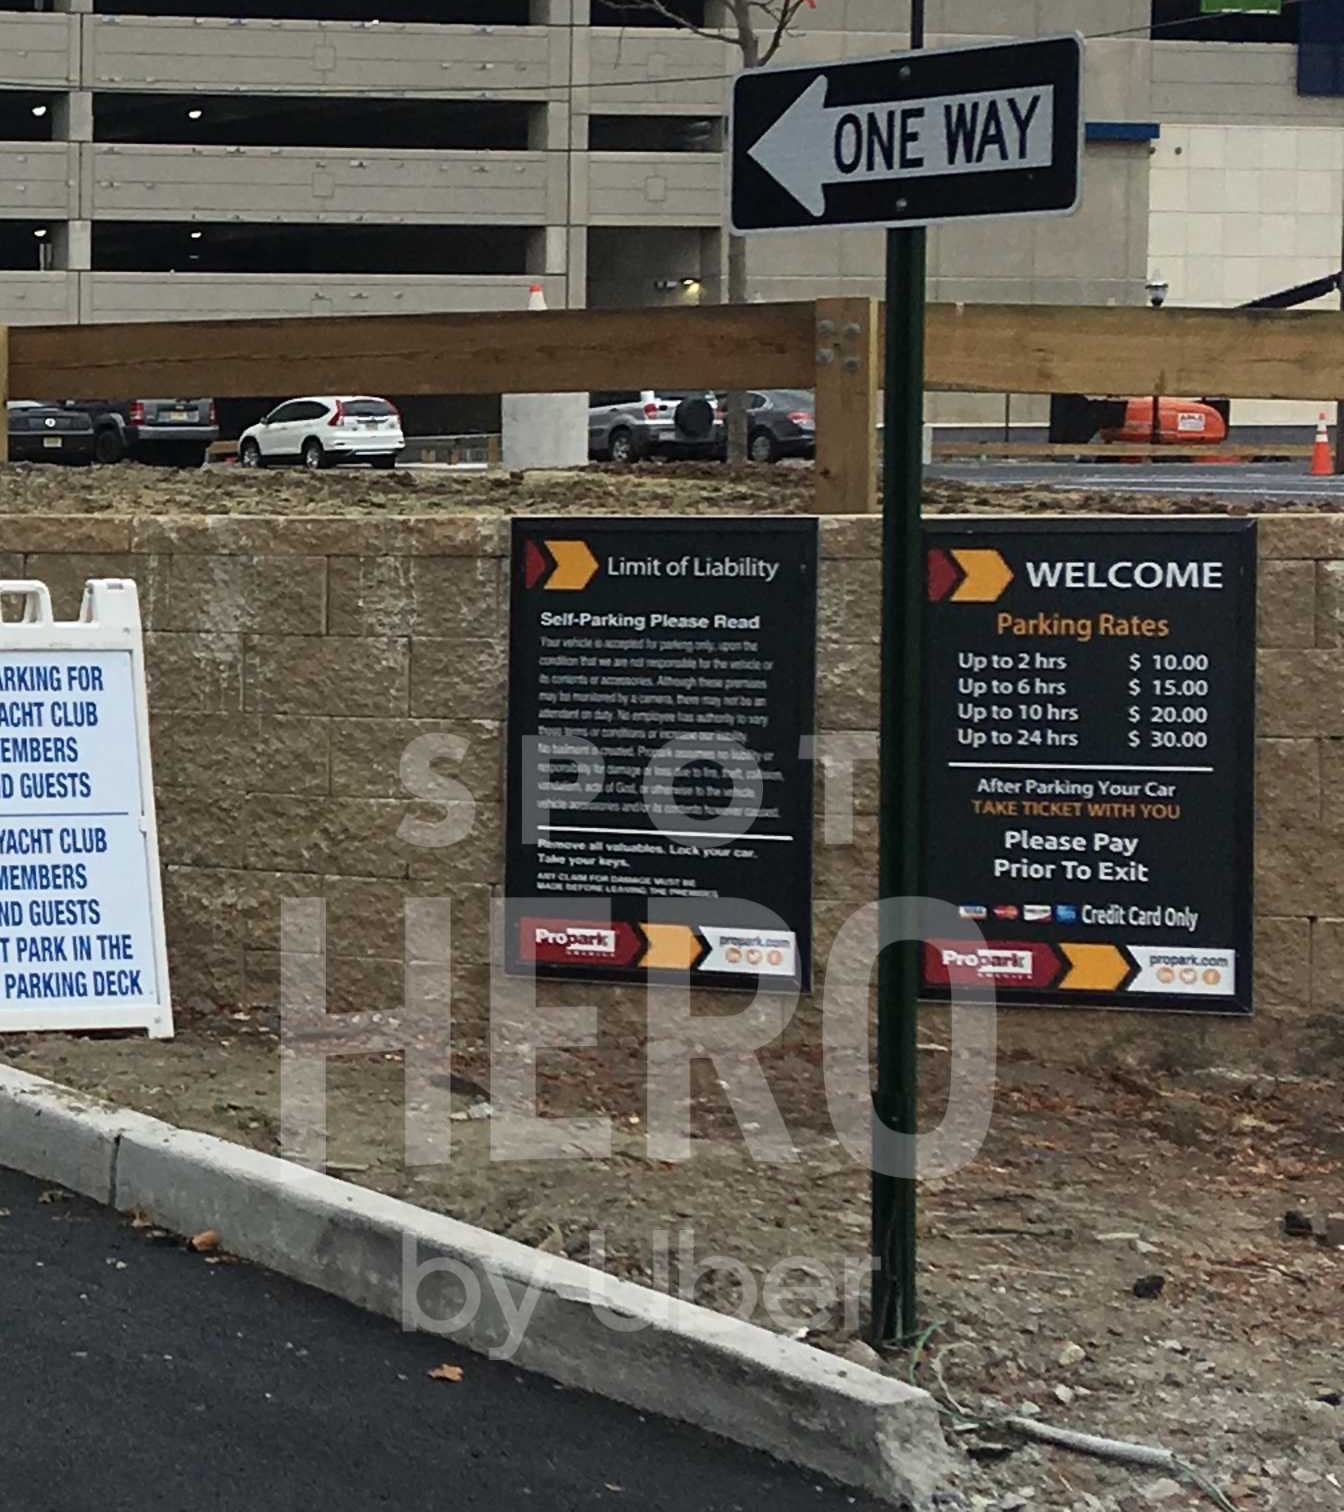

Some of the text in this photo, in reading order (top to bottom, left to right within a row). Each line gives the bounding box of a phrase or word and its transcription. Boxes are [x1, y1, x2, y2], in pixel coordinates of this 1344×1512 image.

[834, 95, 1040, 174] ONE WAY
[608, 556, 779, 581] Limit of Liability
[1026, 562, 1223, 588] WELCOME
[540, 612, 760, 630] Self-Parking Please Read
[997, 614, 1168, 640] Parking Rates
[958, 653, 1208, 674] Up to 2 hrs $ 10.00
[67, 666, 103, 690] FOR
[958, 678, 1208, 699] Up to 6 hrs $ 15.00
[51, 702, 98, 726] CLUB
[958, 704, 1207, 725] Up to 10 hrs $ 20.00
[958, 729, 1207, 750] Up to 24 hrs $ 30.00
[20, 773, 91, 797] GUESTS
[978, 779, 1175, 799] After Parking Your Car
[972, 800, 1180, 819] TAKE TICKET WITH YOU
[59, 828, 106, 852] CLUB
[538, 839, 586, 851] Remove
[589, 840, 602, 851] all
[669, 845, 698, 855] Lock
[703, 847, 731, 857] your
[734, 848, 758, 858] car.
[1005, 831, 1138, 855] Please Pay
[538, 855, 565, 864] Take
[569, 857, 595, 867] your
[994, 860, 1149, 882] Prior To Exit
[29, 901, 100, 925] GUESTS
[1082, 906, 1125, 926] Credit
[1128, 907, 1161, 927] Card
[1165, 907, 1197, 931] Only
[16, 937, 64, 961] PARK
[73, 936, 92, 960] IN
[96, 934, 133, 959] THE
[536, 929, 609, 948] Propark
[719, 936, 790, 947] propark.com
[942, 950, 1027, 971] Propark
[1149, 954, 1228, 969] propark.com
[5, 972, 87, 999] PARKING
[94, 970, 143, 996] DECK
